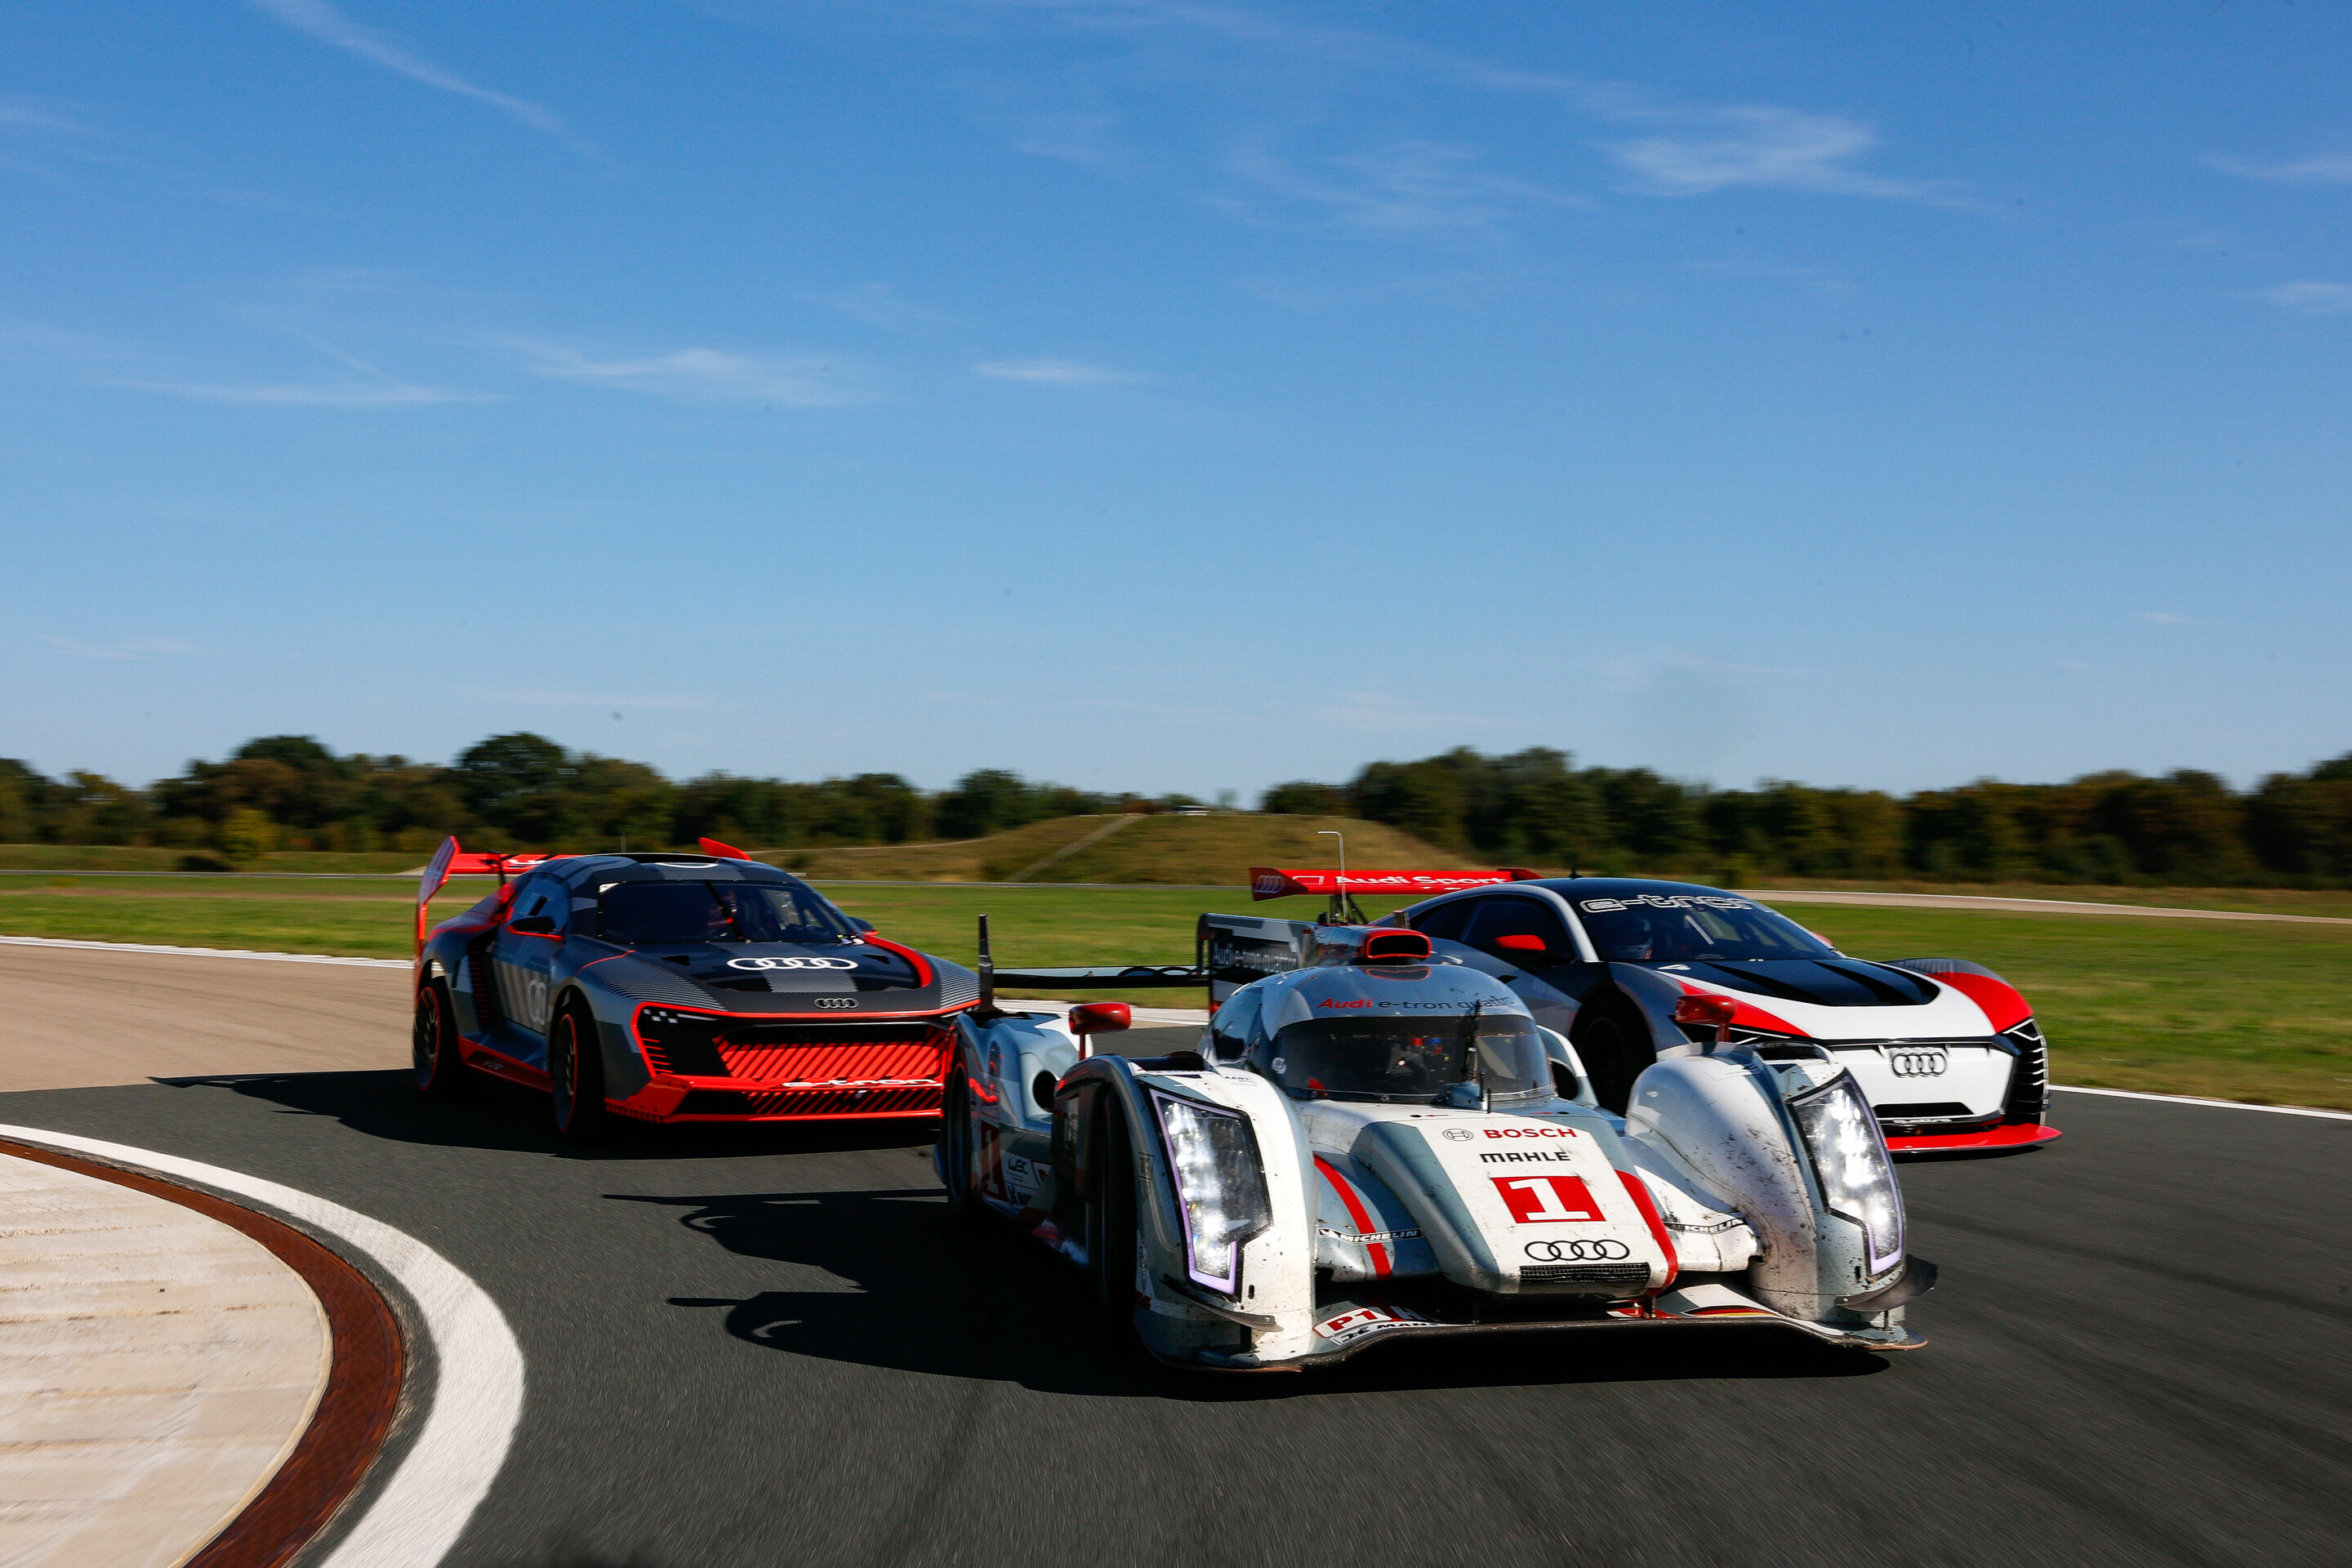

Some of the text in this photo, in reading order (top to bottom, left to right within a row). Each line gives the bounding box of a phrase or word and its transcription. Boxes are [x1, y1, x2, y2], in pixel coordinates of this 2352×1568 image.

[1335, 875, 1506, 884] Audi Sport
[1579, 894, 1770, 913] e-tron
[1214, 941, 1234, 967] Audi
[1317, 998, 1373, 1009] Audi
[1378, 1000, 1452, 1009] e-tron
[782, 1079, 937, 1088] e-tron
[1483, 1129, 1578, 1138] BOSCH
[1480, 1152, 1571, 1163] MAHLE
[1508, 1178, 1592, 1221] 1
[1675, 1218, 1744, 1233] ICHELIN
[1339, 1230, 1418, 1242] MICHELIN
[1327, 1310, 1379, 1332] P1
